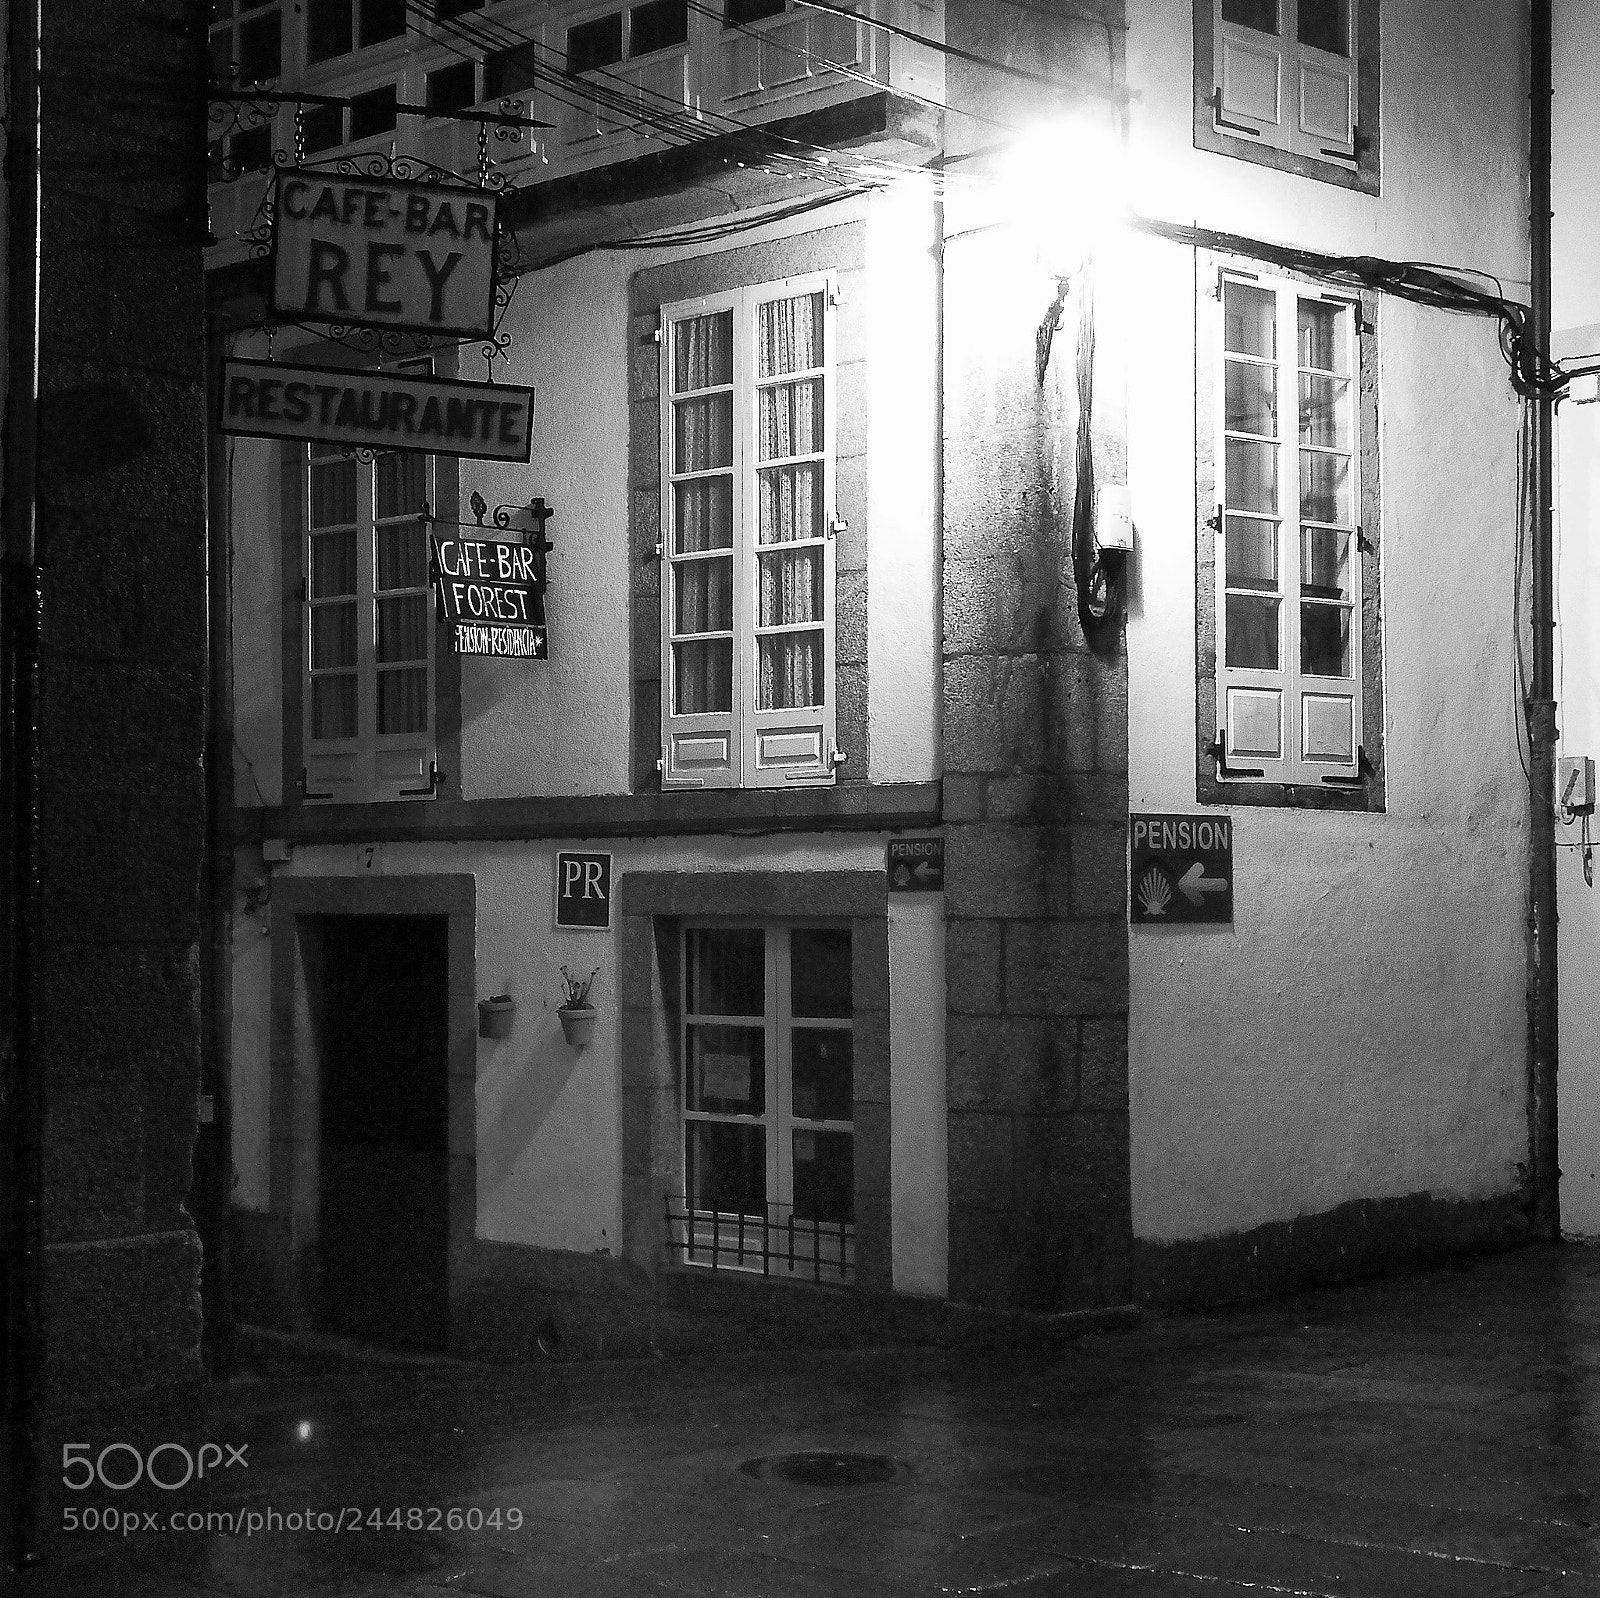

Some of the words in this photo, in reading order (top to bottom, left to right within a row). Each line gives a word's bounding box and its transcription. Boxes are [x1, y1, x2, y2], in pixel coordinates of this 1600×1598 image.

[284, 180, 493, 241] CAFE-BAR
[306, 238, 463, 322] REY
[229, 376, 523, 443] RESTAURANTE
[441, 541, 537, 581] CAFE-BAR
[452, 583, 528, 620] FOREST
[891, 842, 942, 856] PENSION
[1134, 820, 1229, 850] PENSION
[365, 847, 374, 869] 7
[562, 860, 606, 899] PR
